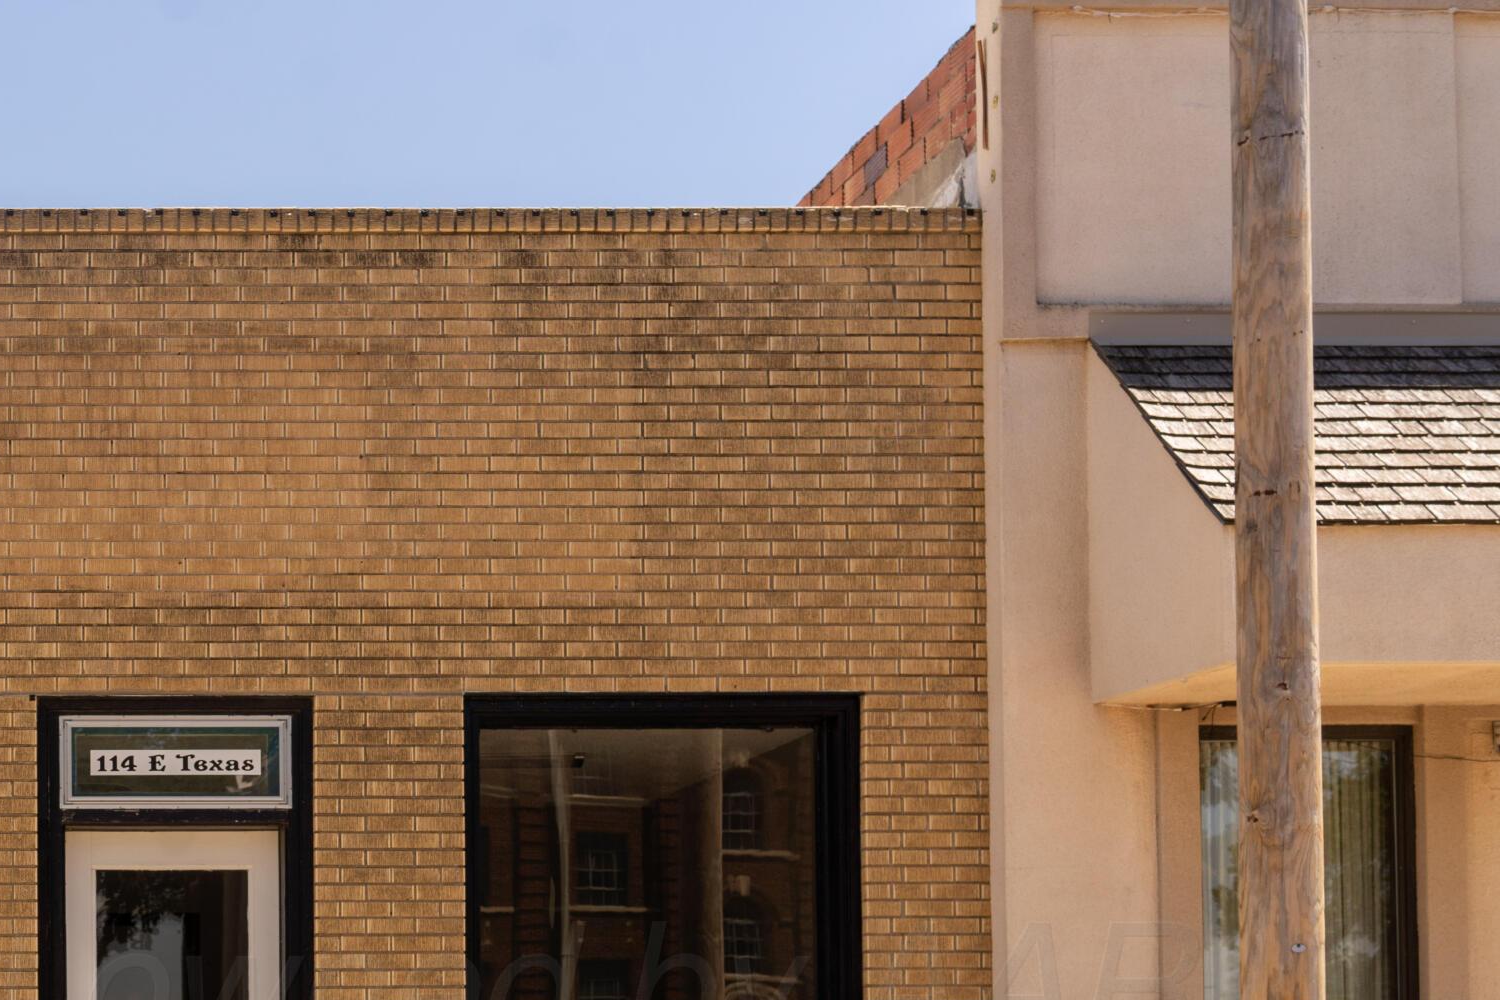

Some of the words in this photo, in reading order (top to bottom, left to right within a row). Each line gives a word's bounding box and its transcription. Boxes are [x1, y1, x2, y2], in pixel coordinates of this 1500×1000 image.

[97, 755, 137, 772] 114
[149, 754, 167, 772] E
[176, 754, 255, 772] Texas
